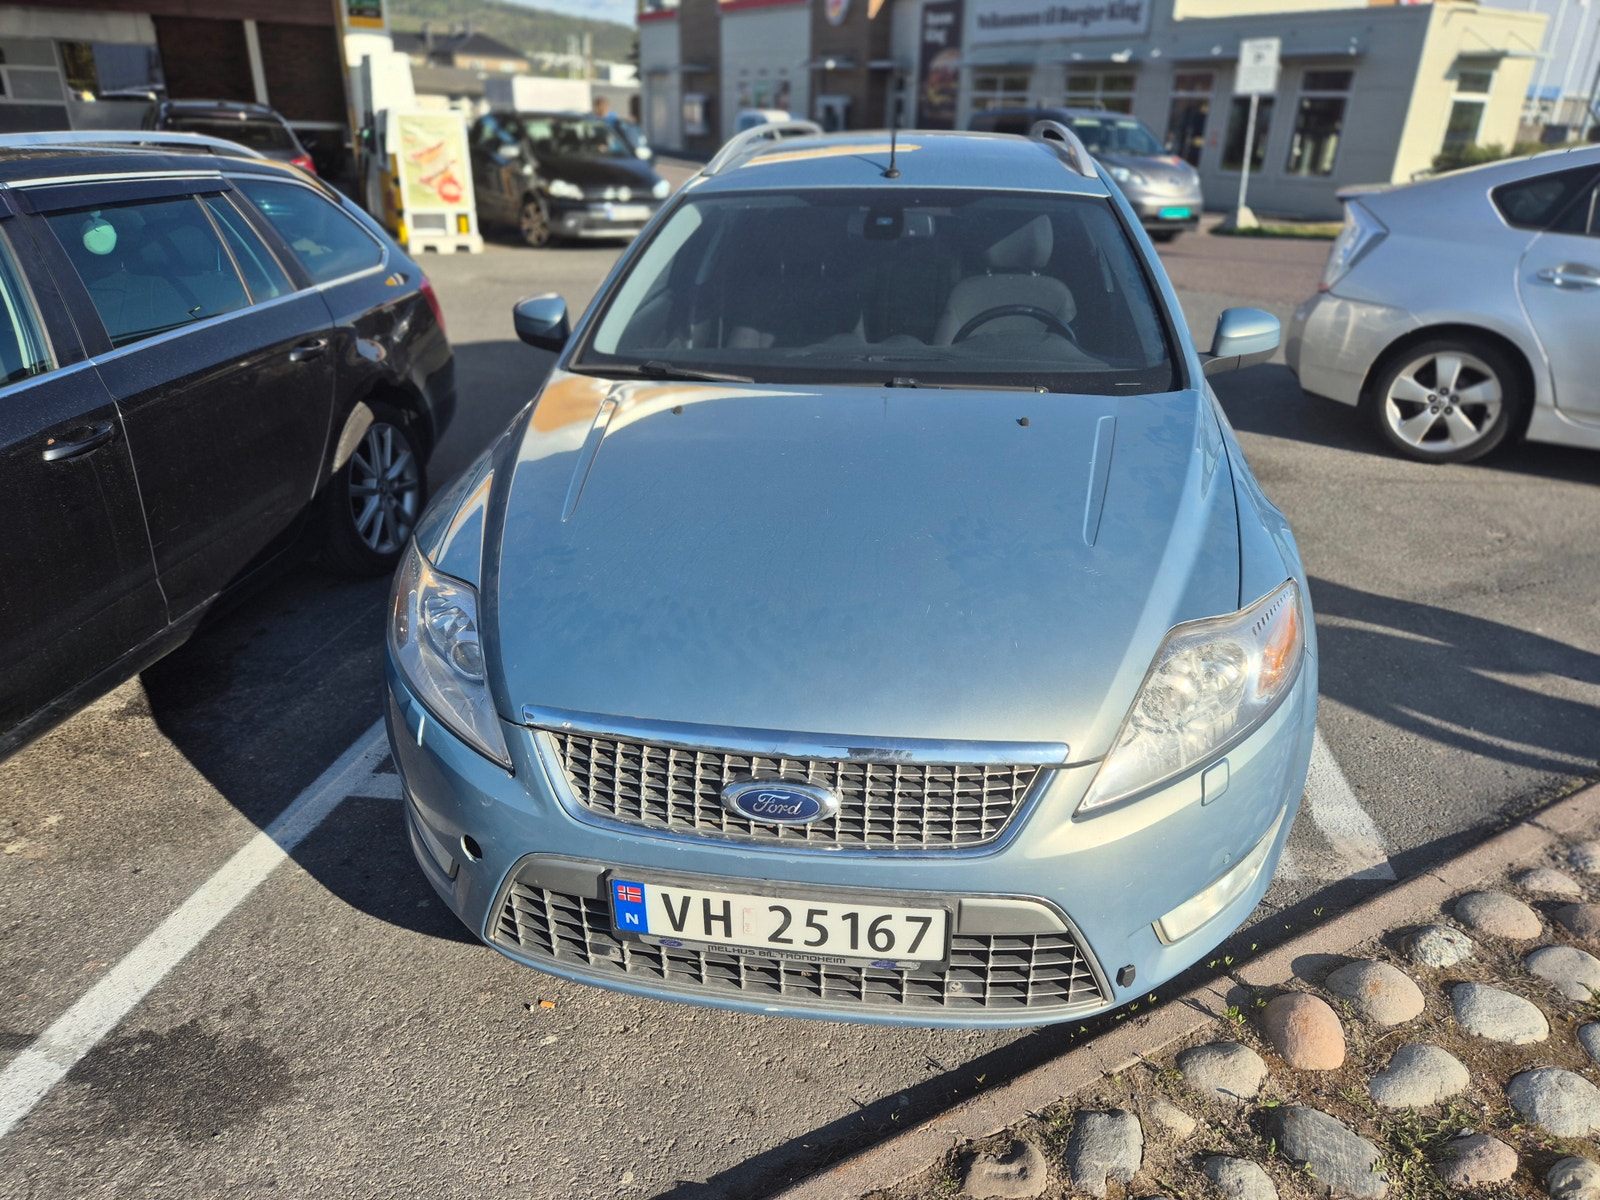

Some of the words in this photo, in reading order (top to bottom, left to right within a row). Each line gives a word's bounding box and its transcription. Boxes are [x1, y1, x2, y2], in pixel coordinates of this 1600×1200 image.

[753, 793, 803, 815] Ford
[625, 912, 639, 925] N
[661, 893, 732, 938] VH
[767, 905, 933, 955] 25167
[707, 944, 756, 956] MELHUS
[779, 951, 847, 965] TRONDHEIM
